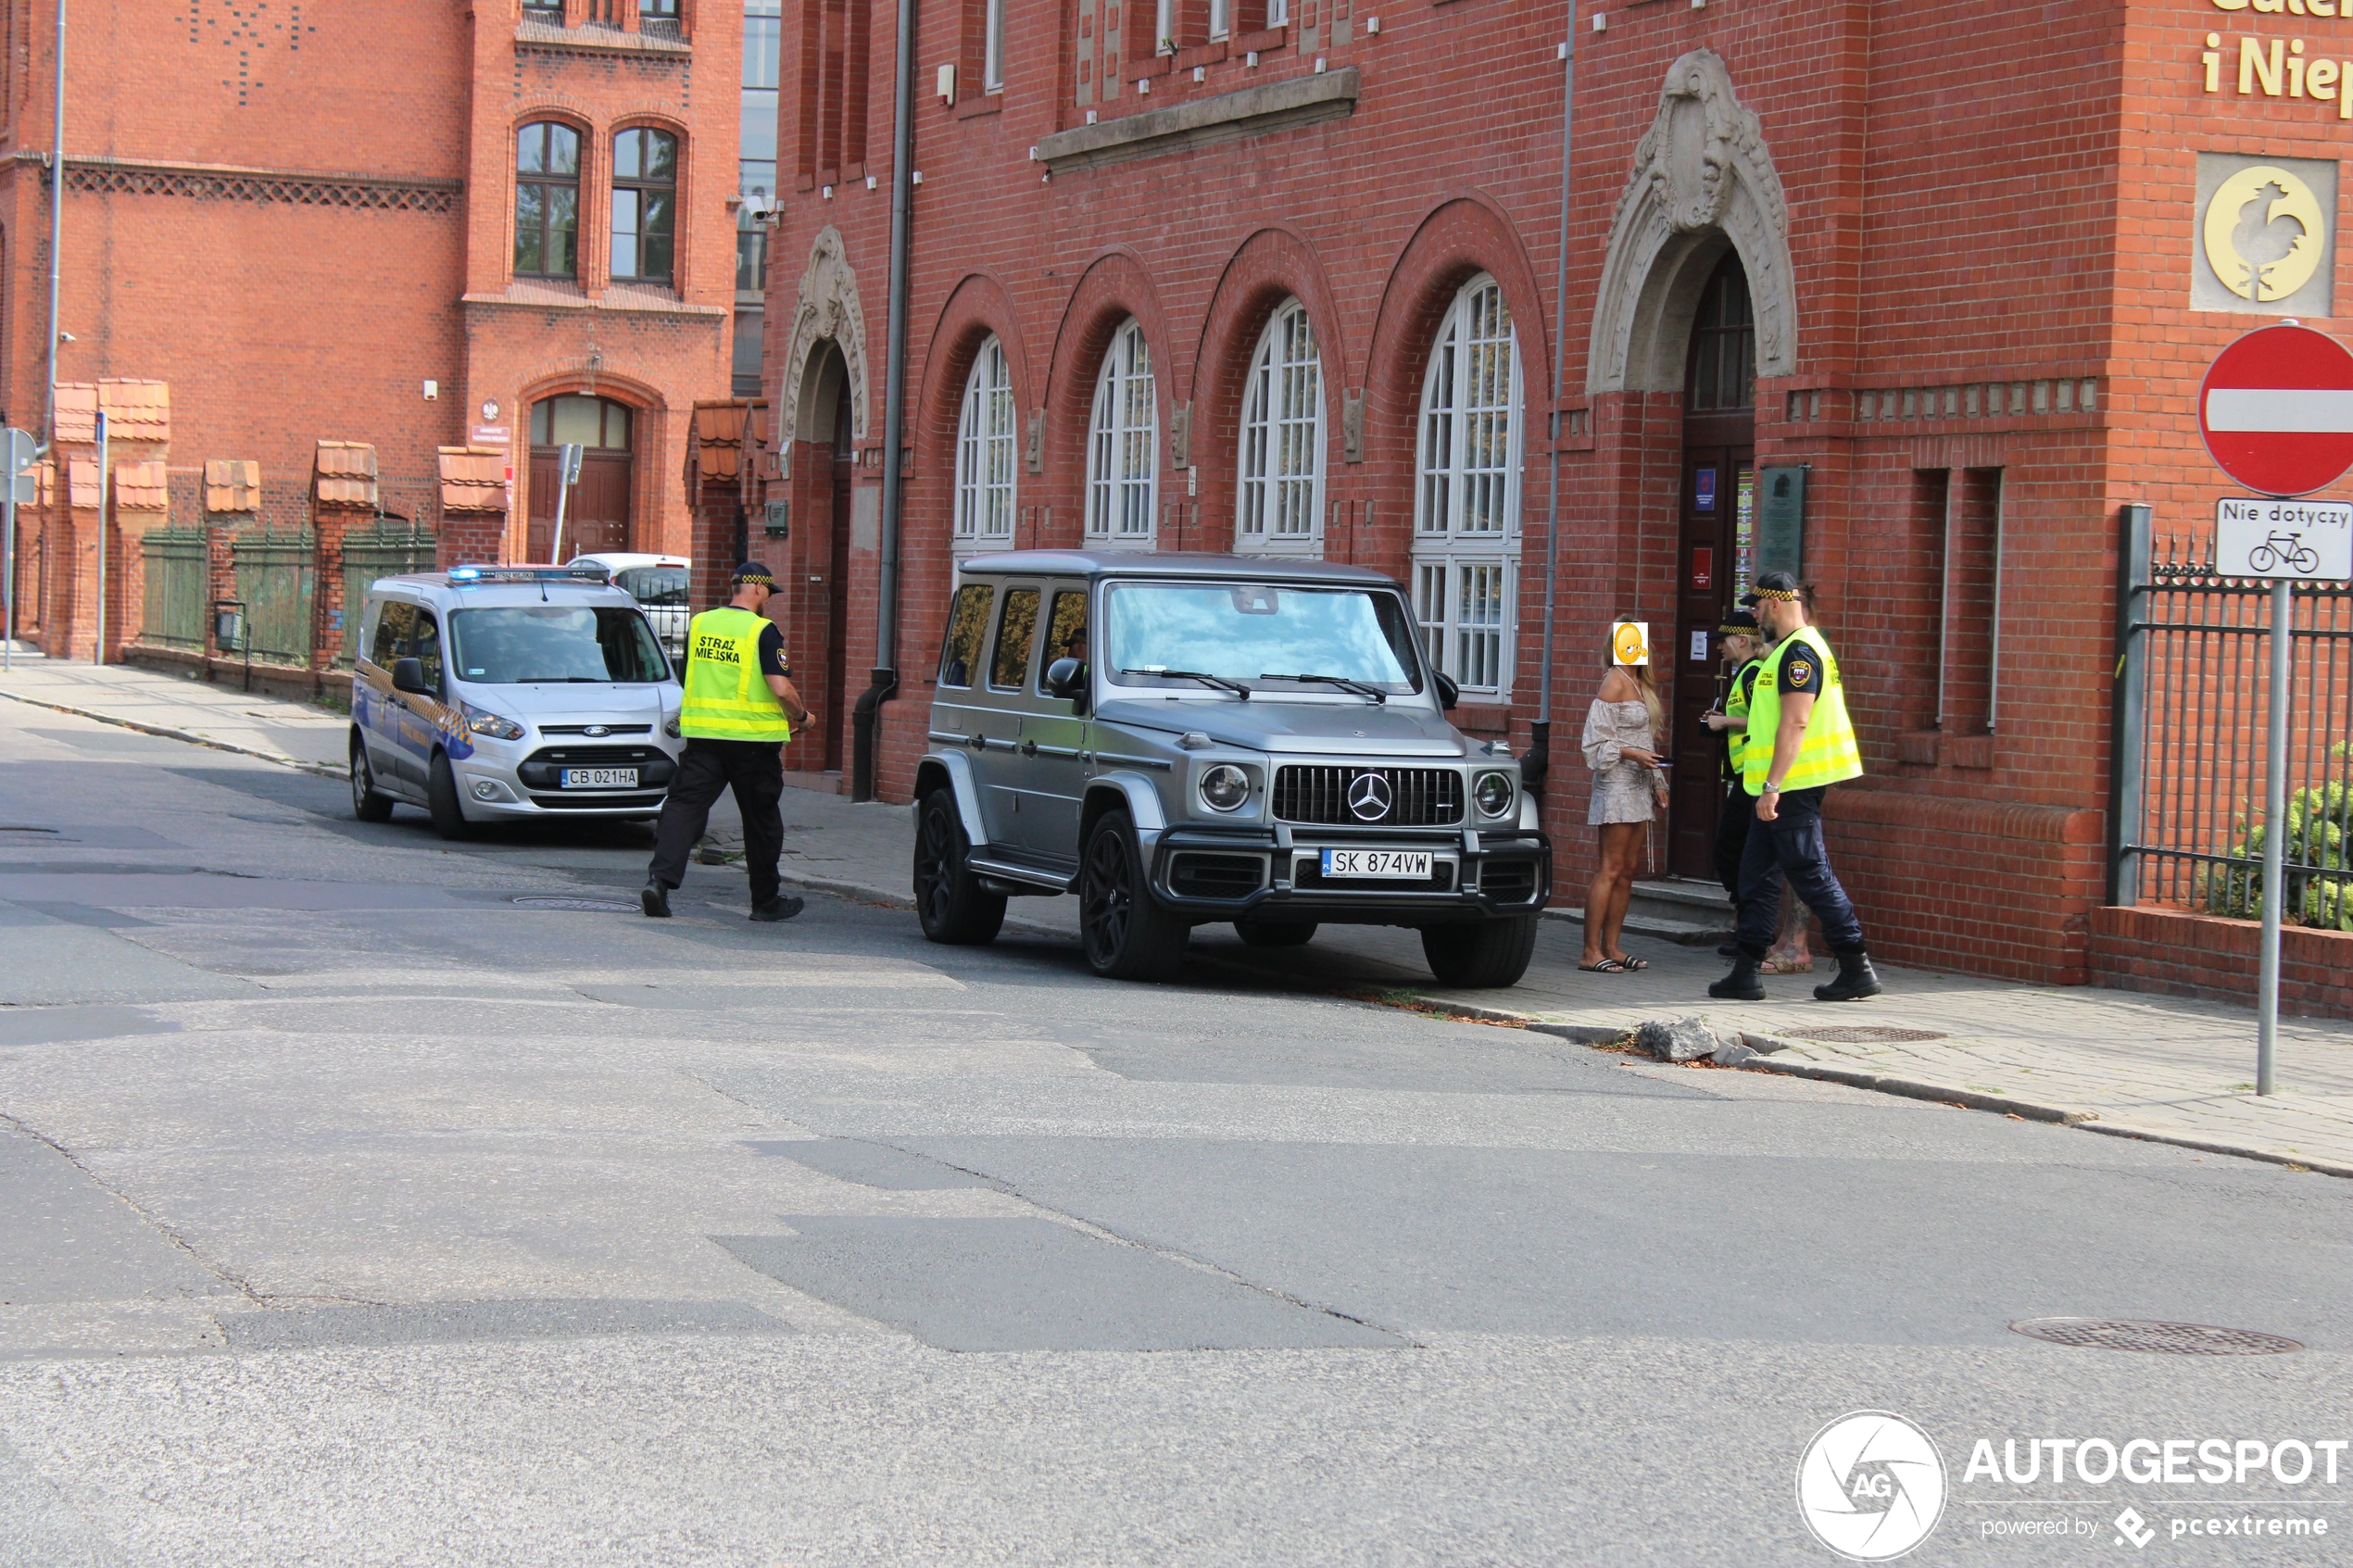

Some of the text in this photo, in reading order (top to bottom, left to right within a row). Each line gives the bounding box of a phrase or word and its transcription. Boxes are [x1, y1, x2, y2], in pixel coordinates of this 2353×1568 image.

[2202, 32, 2221, 93] i
[2224, 503, 2349, 529] Nie dotyczy
[699, 636, 736, 650] STRAŻ
[695, 647, 740, 663] MIEJSKA
[570, 771, 590, 784] CB
[594, 770, 636, 784] 021HA
[1336, 852, 1359, 872] SK
[1367, 853, 1428, 873] 874VW
